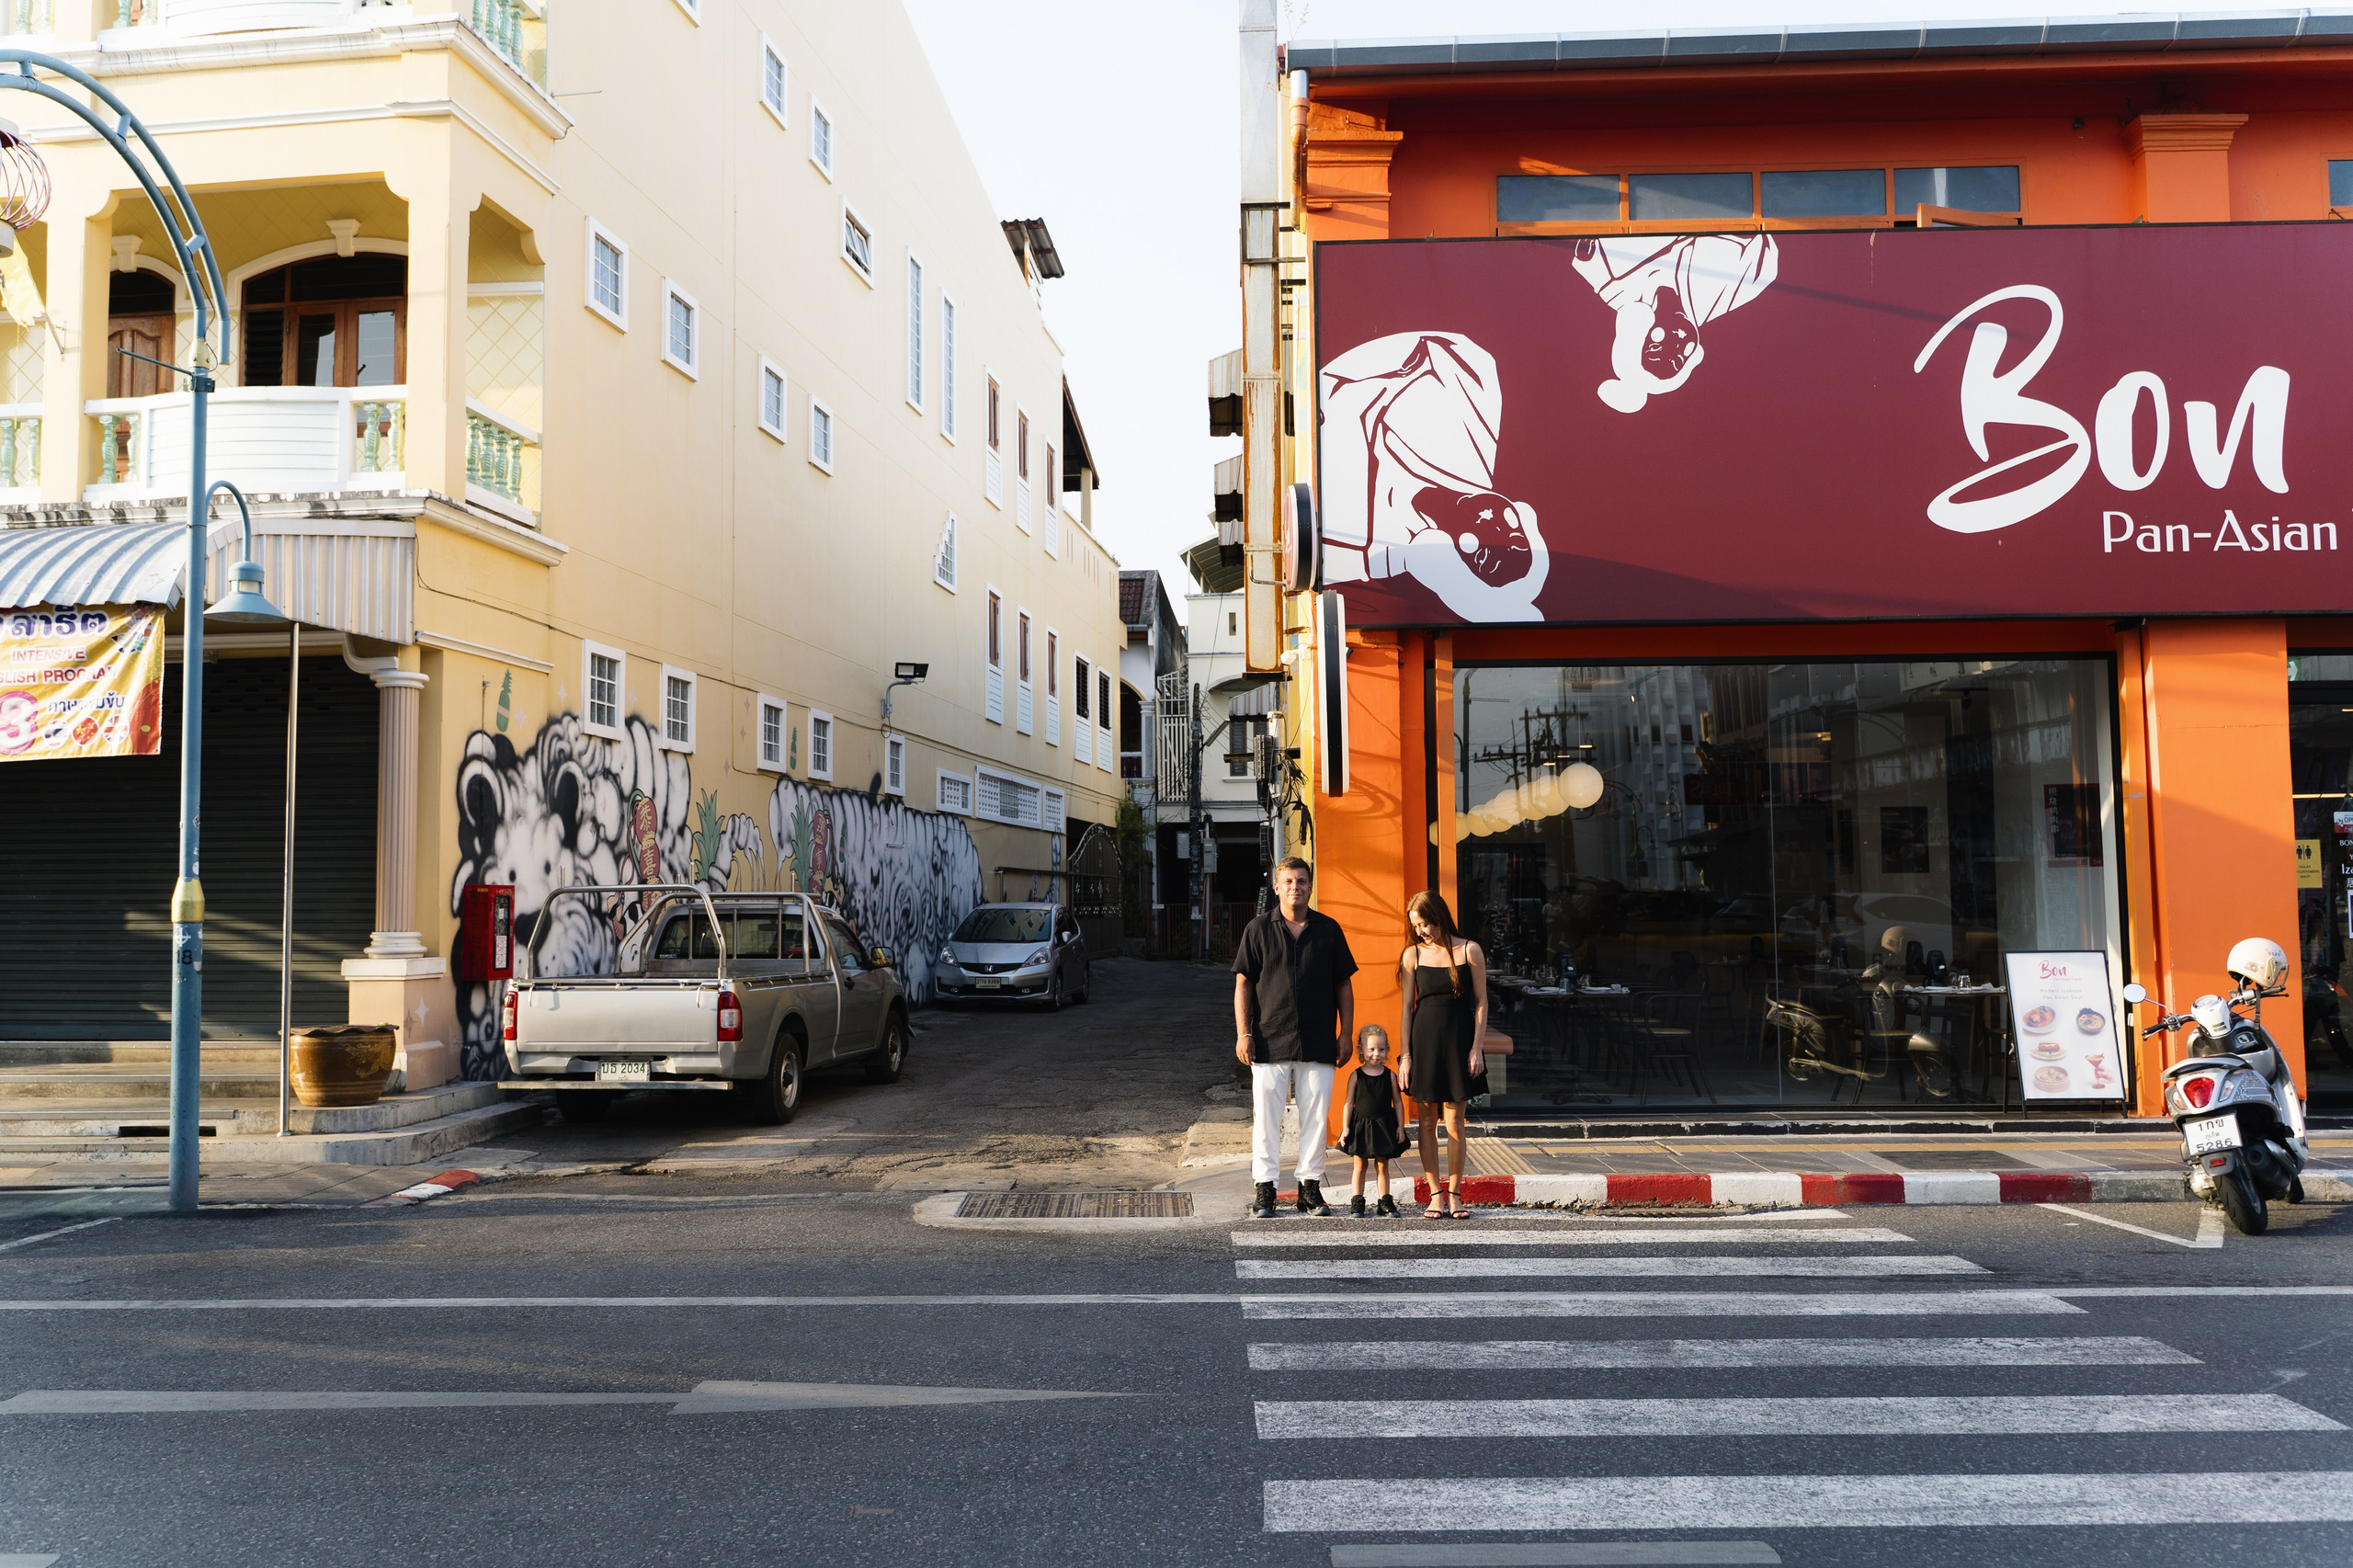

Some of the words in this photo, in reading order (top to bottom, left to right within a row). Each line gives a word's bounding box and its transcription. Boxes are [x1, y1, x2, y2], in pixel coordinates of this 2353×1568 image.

[1914, 284, 2290, 534] Bon
[2102, 509, 2338, 553] Pan-Asian
[0, 603, 108, 637] สาธิต
[12, 648, 85, 661] INTENSIVE
[44, 666, 117, 683] PROGRA
[176, 949, 193, 965] 18
[2038, 960, 2066, 979] Bon
[620, 1062, 645, 1074] 2034
[2196, 1138, 2234, 1153] 5286
